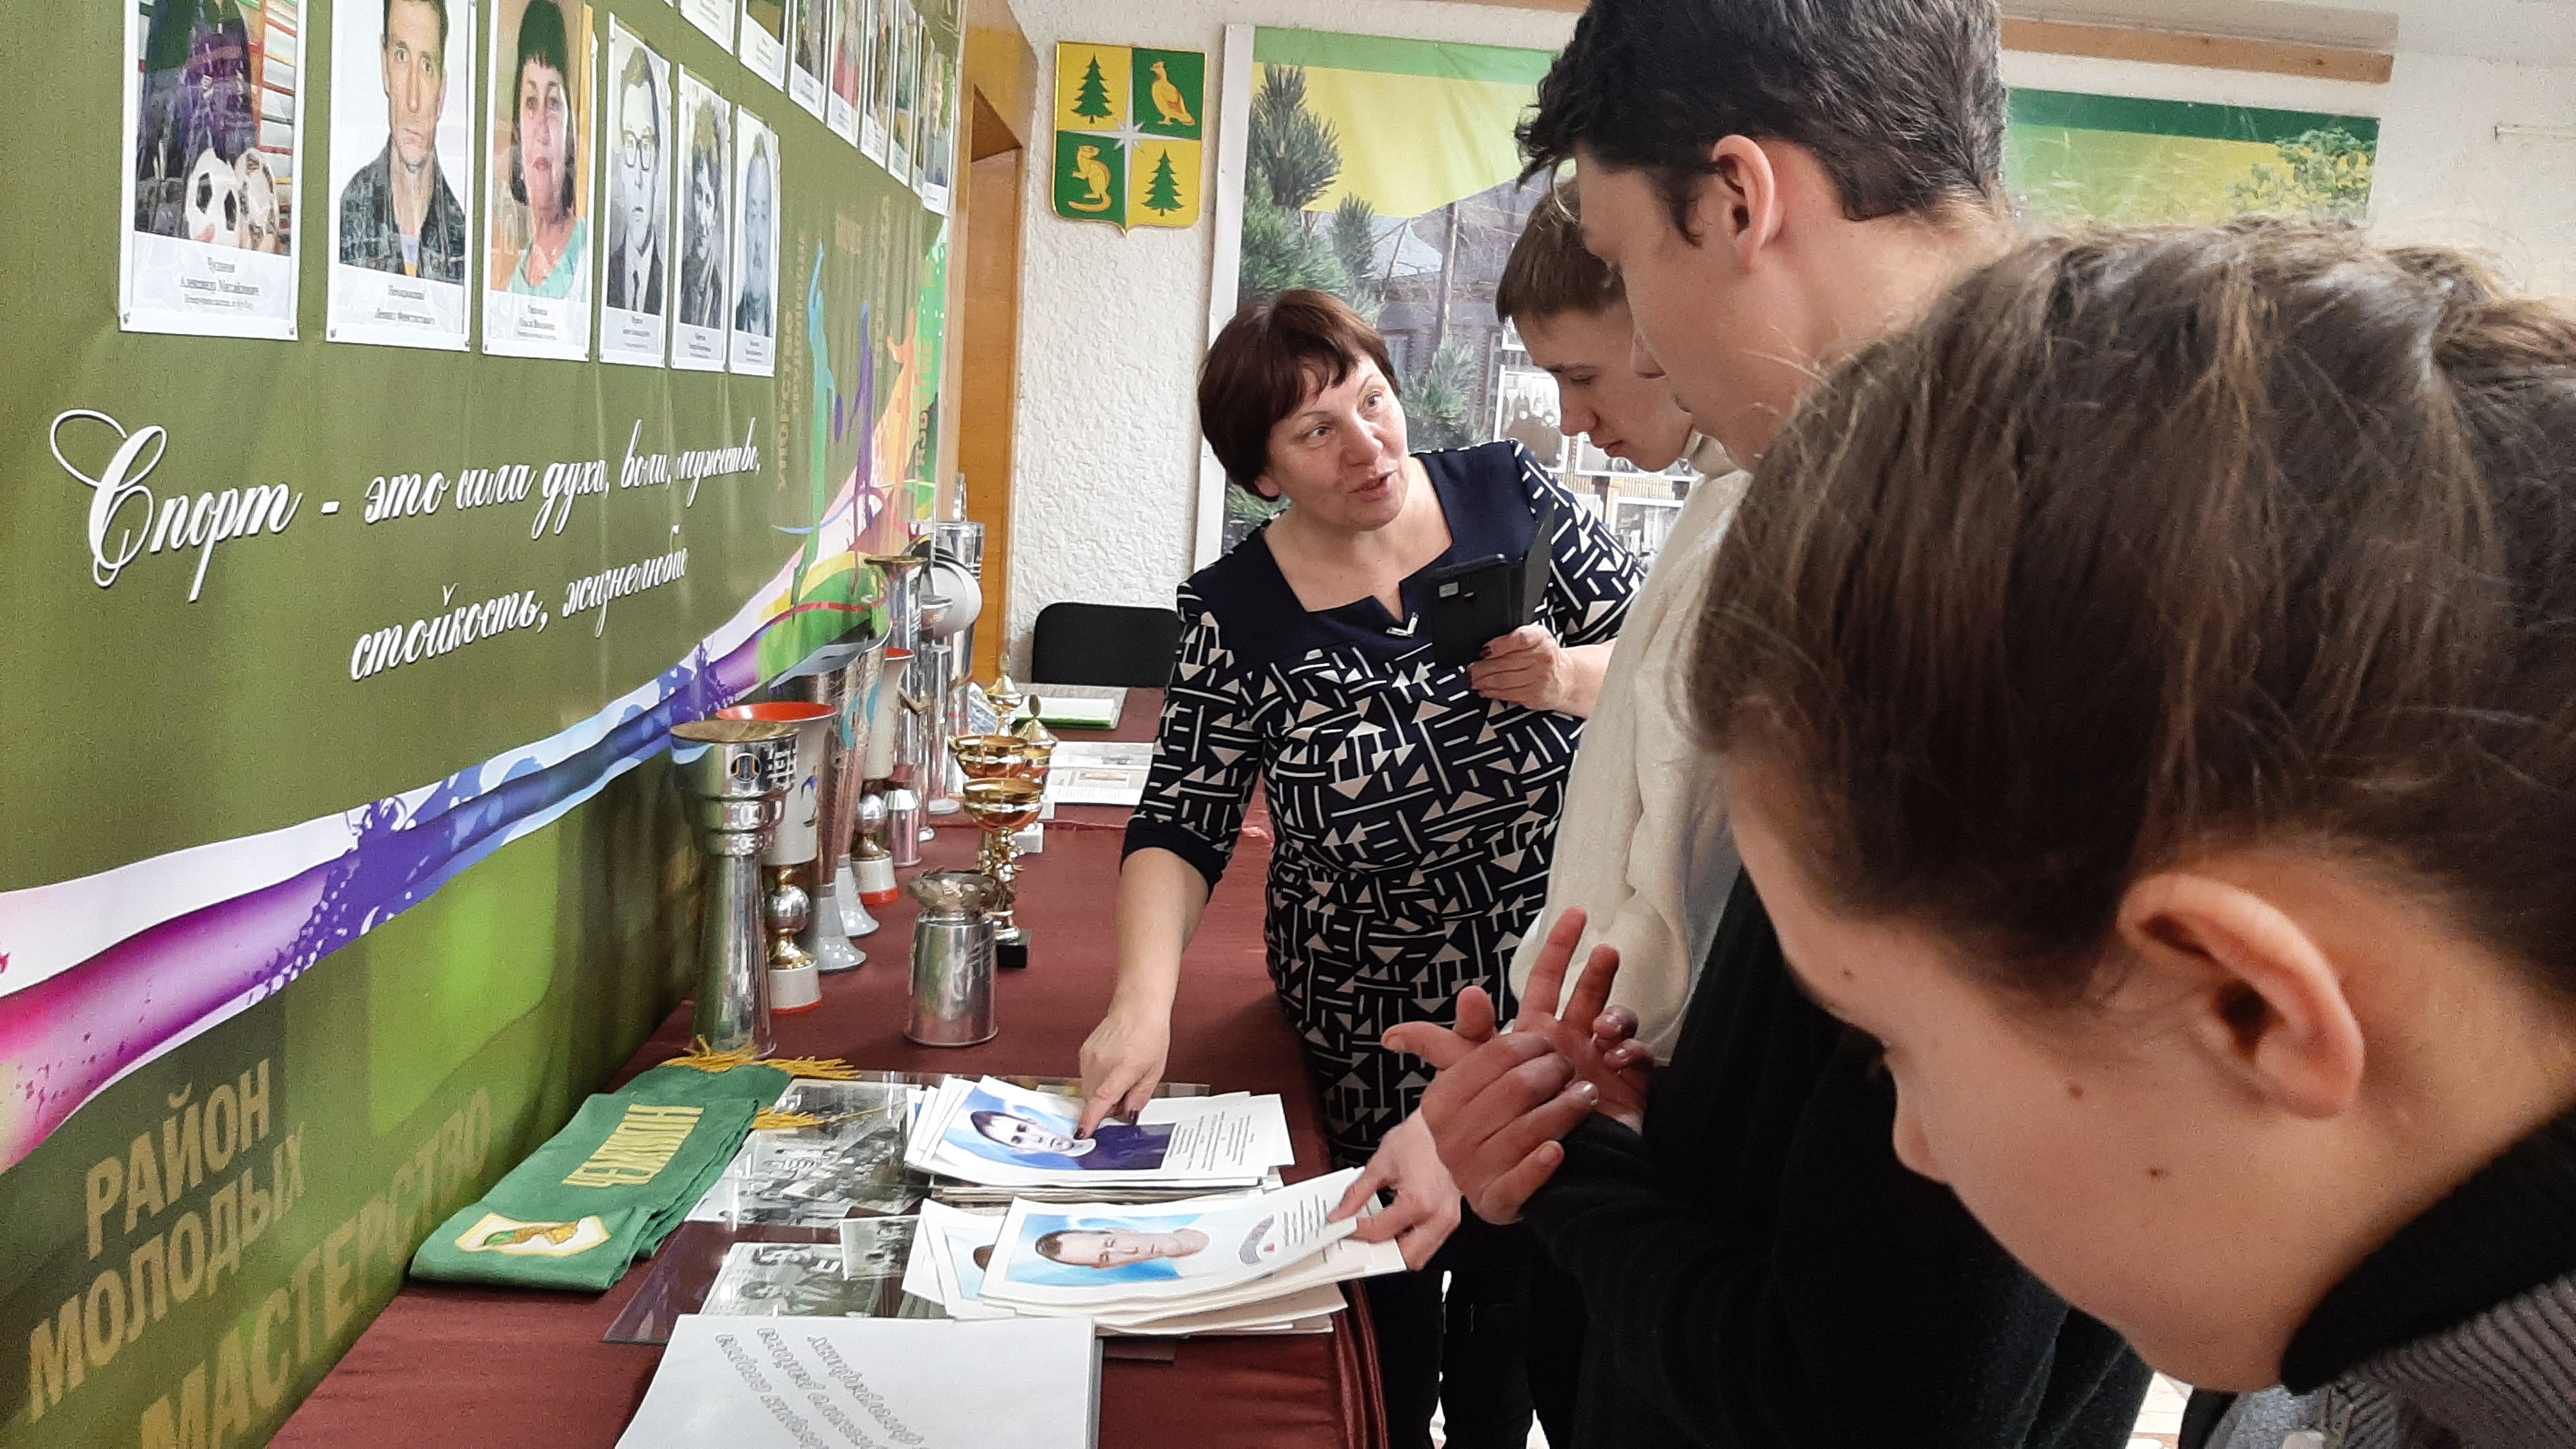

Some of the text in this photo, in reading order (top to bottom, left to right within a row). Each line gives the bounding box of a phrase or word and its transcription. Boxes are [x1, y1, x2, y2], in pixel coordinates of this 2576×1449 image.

[50, 409, 303, 602] Спорт
[365, 471, 451, 524] это
[456, 464, 537, 510] сила
[531, 459, 610, 539] духа,
[621, 419, 671, 489] воли,
[351, 524, 688, 681] стойкость, жизнелюбие
[85, 1058, 271, 1261] РАЙОН
[562, 1103, 705, 1187] ЧЕМПИОН
[28, 1122, 306, 1423] МОЛОДЫХ
